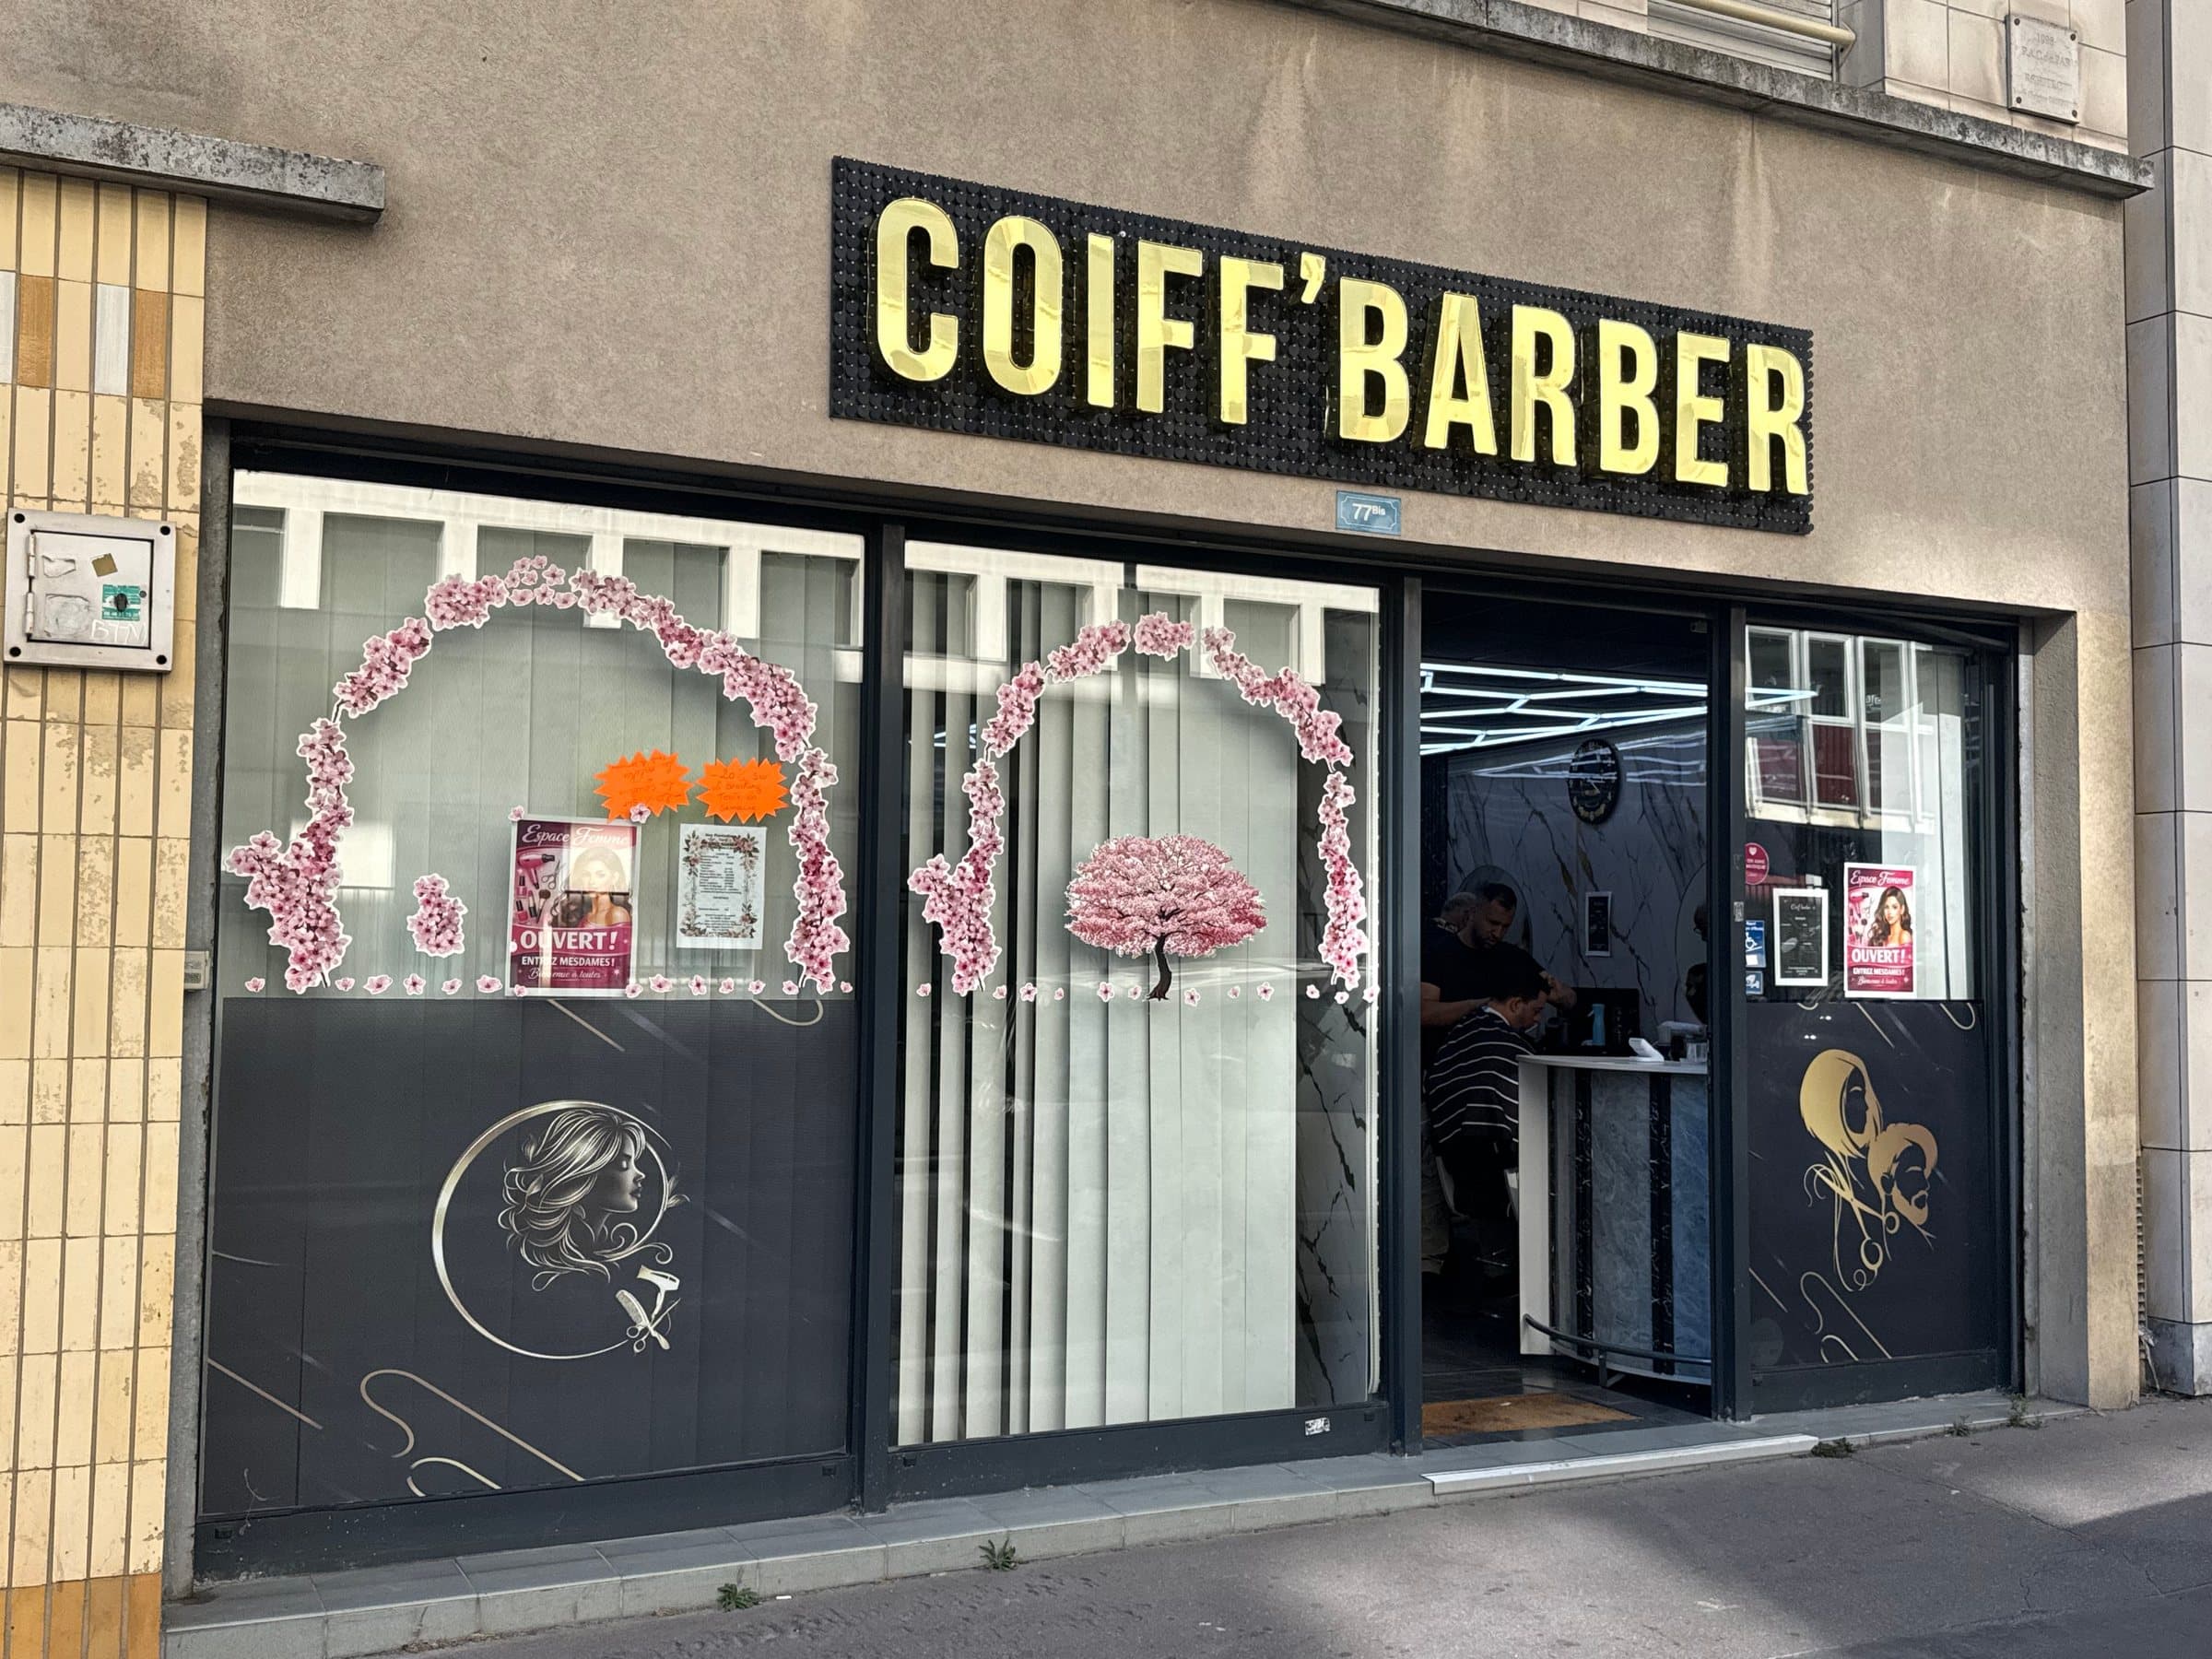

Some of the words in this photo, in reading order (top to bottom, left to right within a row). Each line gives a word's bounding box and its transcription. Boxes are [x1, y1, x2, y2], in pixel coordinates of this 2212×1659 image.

[875, 197, 1809, 495] COIFF'BARBER
[522, 823, 570, 846] Espace
[1850, 869, 1877, 887] Espace
[1877, 871, 1911, 886] Femme
[522, 956, 558, 966] ENTZ
